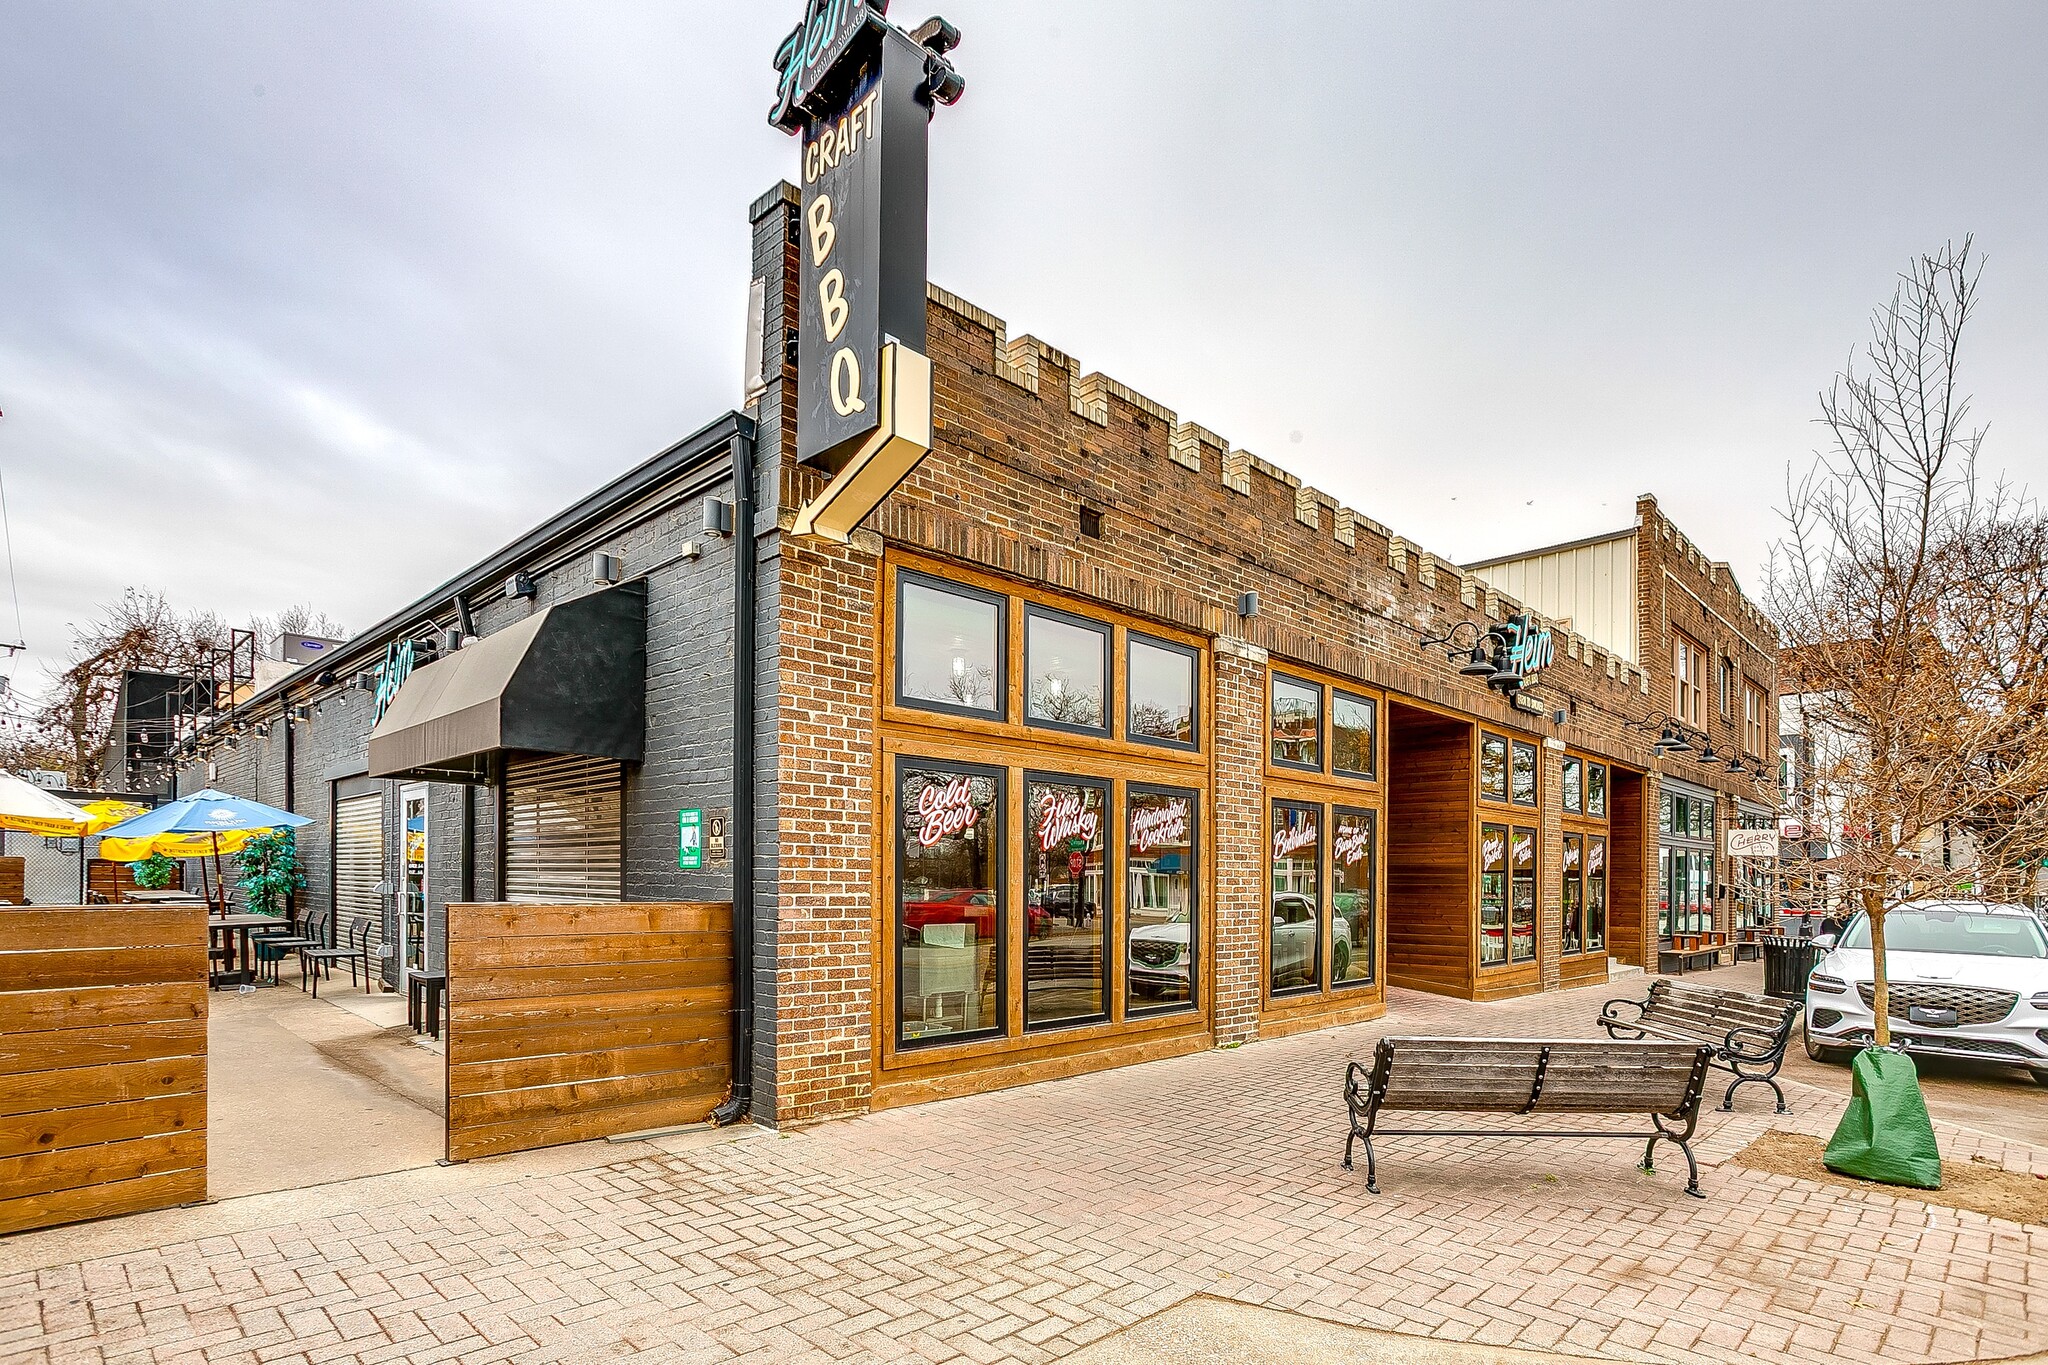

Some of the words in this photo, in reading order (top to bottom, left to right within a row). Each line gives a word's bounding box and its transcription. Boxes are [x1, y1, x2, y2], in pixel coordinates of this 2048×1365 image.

[768, 0, 864, 122] Hei
[810, 57, 828, 85] FARM
[828, 47, 837, 61] TO
[837, 9, 865, 48] SMOKER
[805, 91, 878, 184] CRAFT
[807, 194, 866, 417] BBQ
[1507, 614, 1555, 689] Heim
[918, 778, 971, 815] Cold
[1040, 793, 1082, 828] Fine
[1132, 798, 1188, 834] Handcrafted
[918, 801, 978, 847] Beer
[1038, 809, 1099, 851] Whiskey
[1138, 817, 1188, 853] Cocktails
[1730, 833, 1776, 850] CHERRY
